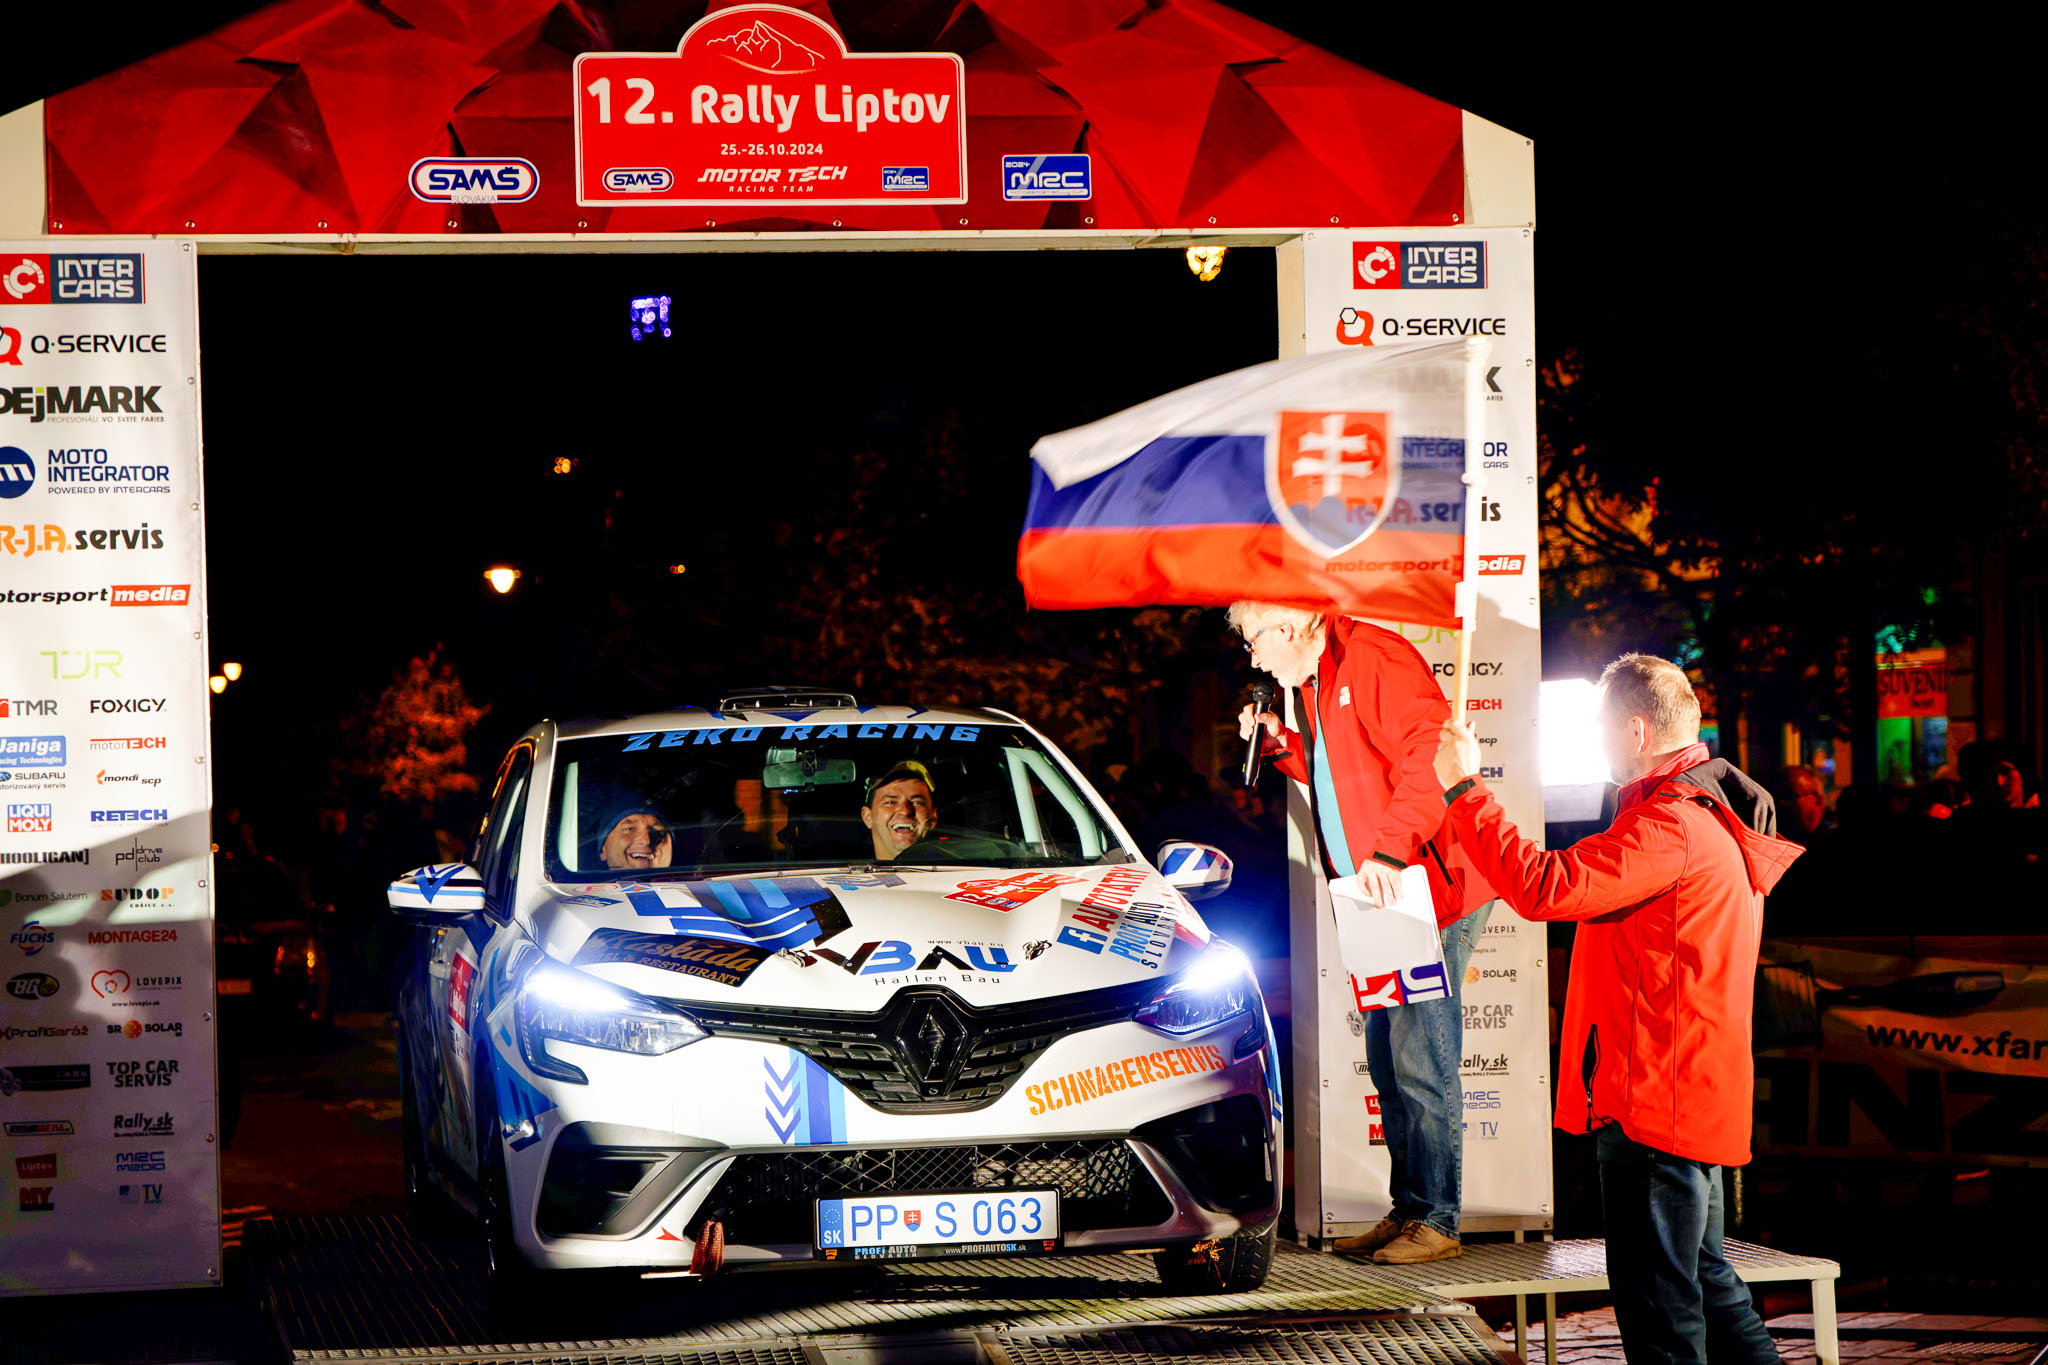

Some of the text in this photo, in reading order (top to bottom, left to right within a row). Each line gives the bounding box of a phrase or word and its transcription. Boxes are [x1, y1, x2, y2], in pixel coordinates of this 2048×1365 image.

[587, 78, 950, 133] 12. Rally Liptov
[720, 143, 824, 156] 25.-26.10.2024
[429, 166, 520, 191] SAMŠ
[697, 165, 848, 182] MOTOR TECH
[887, 176, 925, 185] MRC
[1011, 172, 1084, 188] MRC
[728, 185, 814, 193] RACING TEAM
[1407, 246, 1477, 265] INTER
[57, 259, 134, 278] INTER
[1408, 266, 1478, 284] CARS
[58, 280, 135, 298] CARS
[48, 449, 108, 464] MOTO
[48, 466, 170, 482] INTEGRATOR
[98, 486, 110, 494] BY
[75, 522, 164, 550] servis
[114, 587, 187, 602] media
[13, 699, 58, 716] TMR
[622, 724, 981, 752] ZEKO RACING
[15, 772, 66, 780] SUBARU
[104, 774, 162, 787] mondi scp
[10, 805, 50, 818] LIQUI
[91, 809, 168, 822] RETECH
[8, 819, 51, 832] MOLY
[10, 932, 55, 944] FUCHS
[88, 930, 178, 944] MONTAGE24
[638, 956, 740, 985] RESTAURANT
[1482, 969, 1517, 978] SOLAR
[136, 976, 182, 986] LOVEPIX
[874, 973, 1000, 986] Hallen Bau
[1483, 1004, 1513, 1017] CAR
[107, 1023, 182, 1034] SR SOLAR
[1464, 1017, 1507, 1029] ERVIS
[106, 1060, 179, 1075] TOP CAR
[115, 1073, 172, 1088] SERVIS
[114, 1112, 173, 1131] Rally.sk
[1480, 1122, 1498, 1136] TV
[142, 1184, 162, 1200] TV
[823, 1197, 1042, 1245] SK PP S 063
[888, 1245, 918, 1254] AUTO
